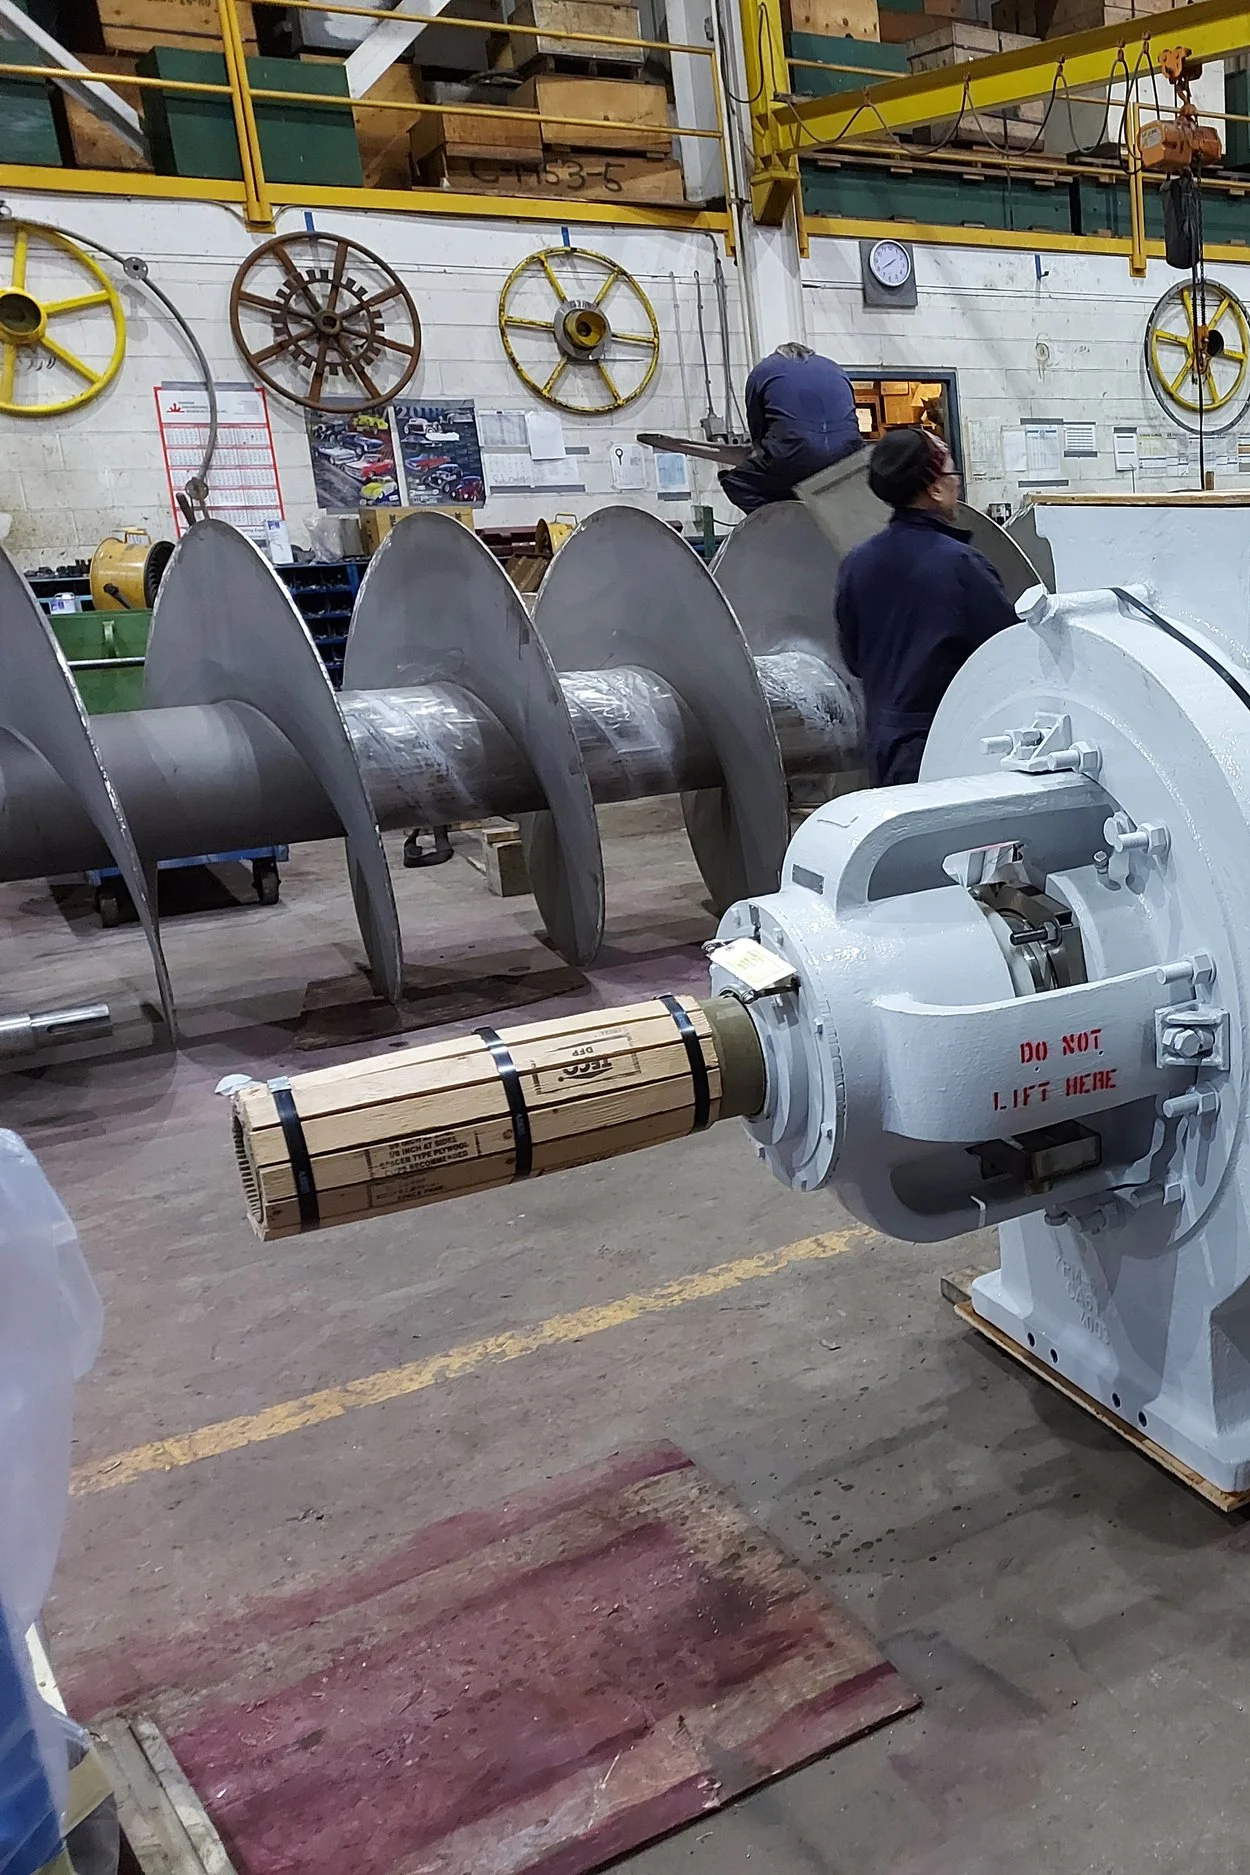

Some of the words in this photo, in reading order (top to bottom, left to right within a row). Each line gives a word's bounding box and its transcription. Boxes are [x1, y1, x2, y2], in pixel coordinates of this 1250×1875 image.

[572, 1046, 594, 1057] DFP
[1020, 1041, 1048, 1064] DO
[1062, 1028, 1103, 1056] NOT
[993, 1081, 1050, 1111] LIFT
[1065, 1068, 1117, 1097] HERE
[402, 1144, 422, 1155] INCH
[423, 1141, 434, 1150] AT
[412, 1150, 433, 1162] TYPE
